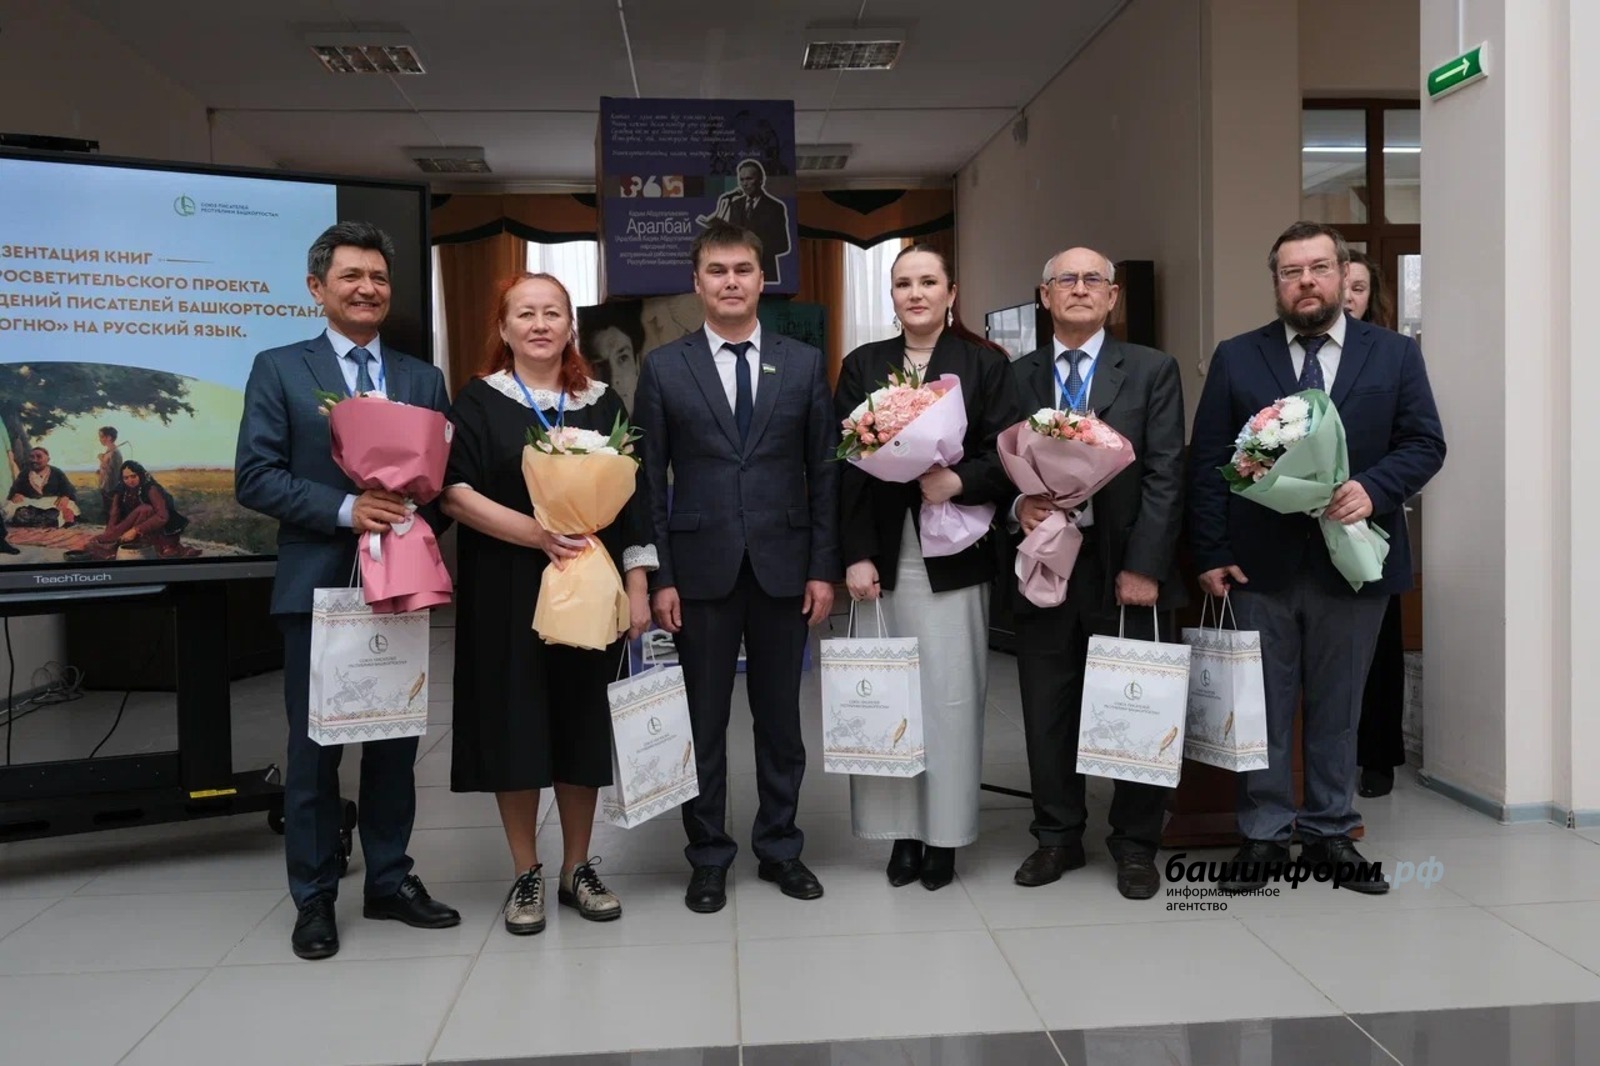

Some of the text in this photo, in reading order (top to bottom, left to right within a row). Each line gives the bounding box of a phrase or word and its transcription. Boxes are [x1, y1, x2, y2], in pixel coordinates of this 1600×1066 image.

[620, 176, 684, 198] 365
[626, 218, 692, 239] Аралбай
[0, 245, 153, 264] ЗЕНТАЦИЯ КНИГ
[192, 278, 270, 294] ПРОЕКТА
[67, 295, 173, 312] ПИСАТЕЛЕЙ
[73, 320, 98, 333] НА
[104, 320, 189, 335] РУССКИЙ
[193, 324, 247, 338] ЯЗЫК.
[33, 573, 112, 584] TeachTouch
